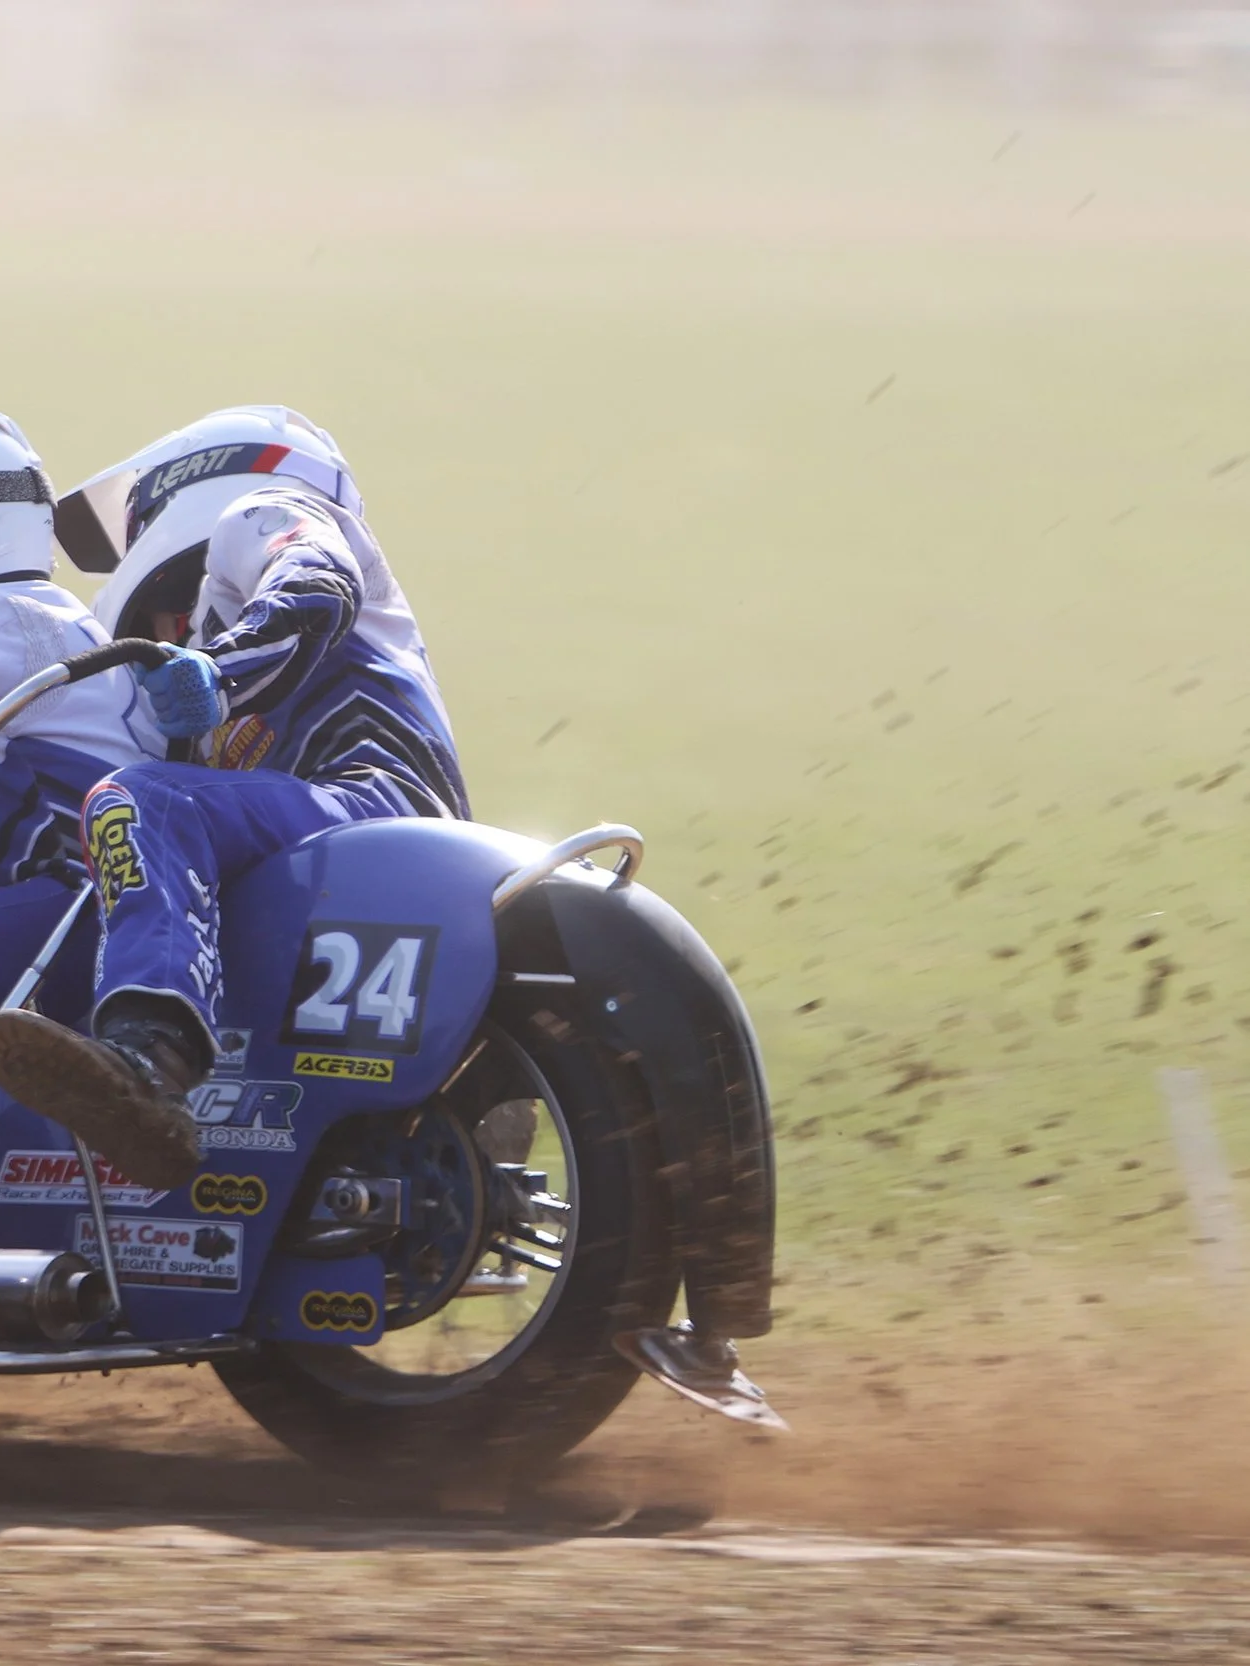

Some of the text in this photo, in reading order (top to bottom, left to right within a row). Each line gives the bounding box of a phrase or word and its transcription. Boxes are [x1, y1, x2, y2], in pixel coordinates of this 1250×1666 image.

[150, 445, 247, 499] LEATT
[294, 931, 423, 1037] 24
[4, 1156, 133, 1186] SIMPS
[81, 1221, 191, 1246] Mck Cave
[124, 1245, 157, 1258] HIRE
[160, 1249, 170, 1259] &
[169, 1261, 236, 1276] SUPPLIES
